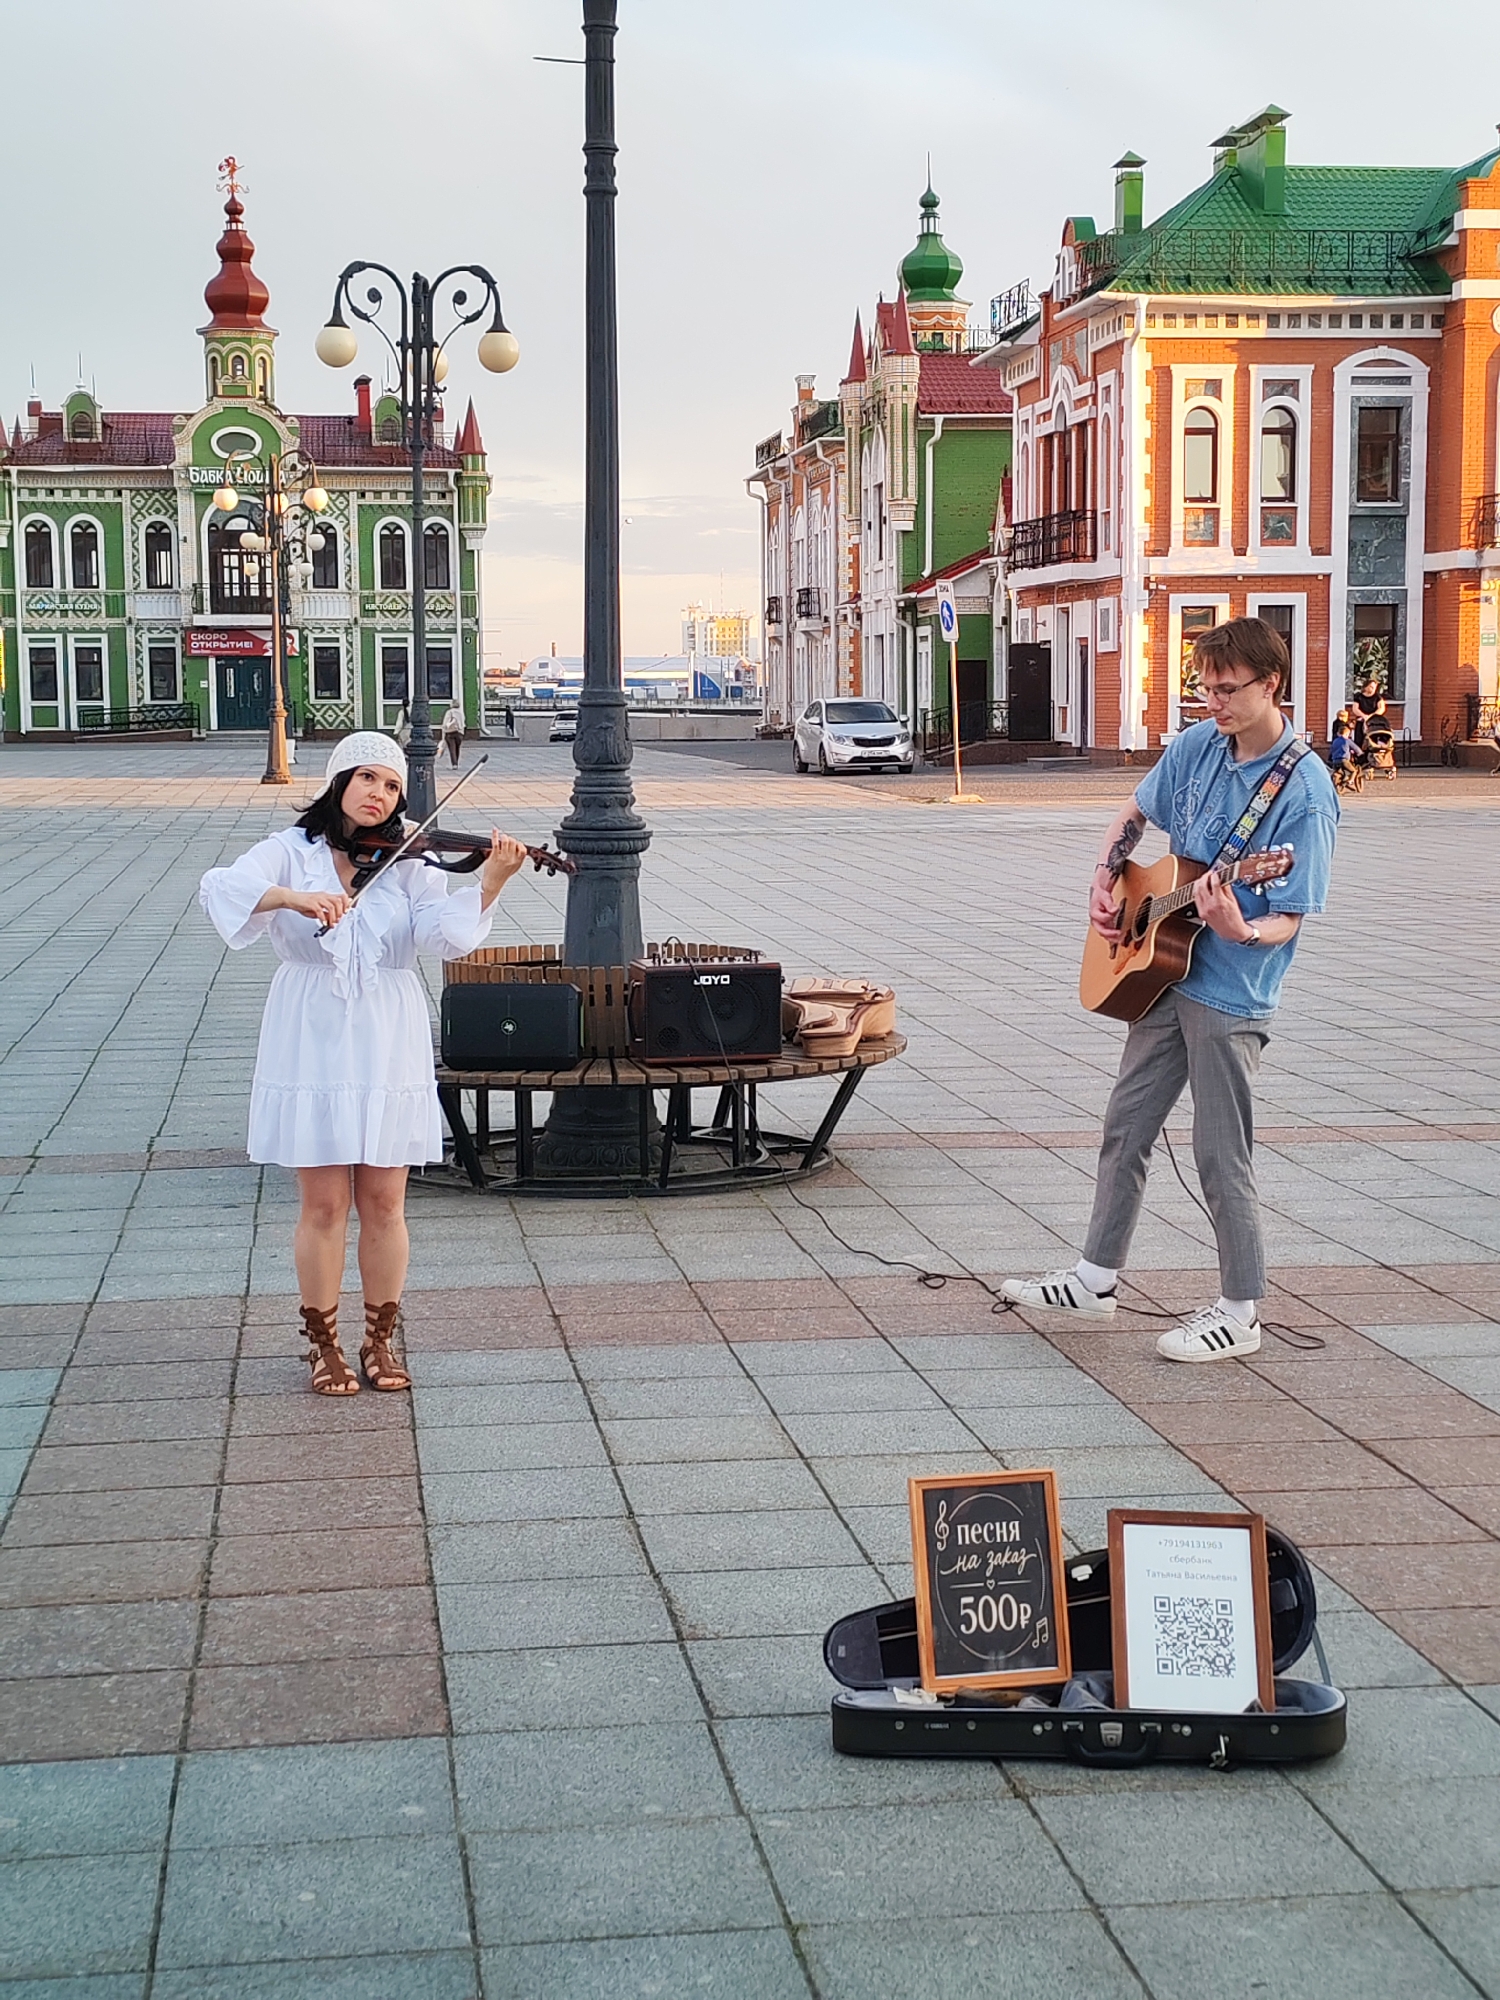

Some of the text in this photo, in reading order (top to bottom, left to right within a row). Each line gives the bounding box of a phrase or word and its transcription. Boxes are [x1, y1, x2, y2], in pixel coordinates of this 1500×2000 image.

[190, 641, 254, 649] ОТКРЫТИЕ!
[693, 974, 730, 986] JOYO
[1158, 1539, 1223, 1549] +79194131963
[940, 1545, 1037, 1577] на заказ
[1169, 1554, 1213, 1565] сбербанк
[1146, 1569, 1238, 1581] Татьяна Васильевна
